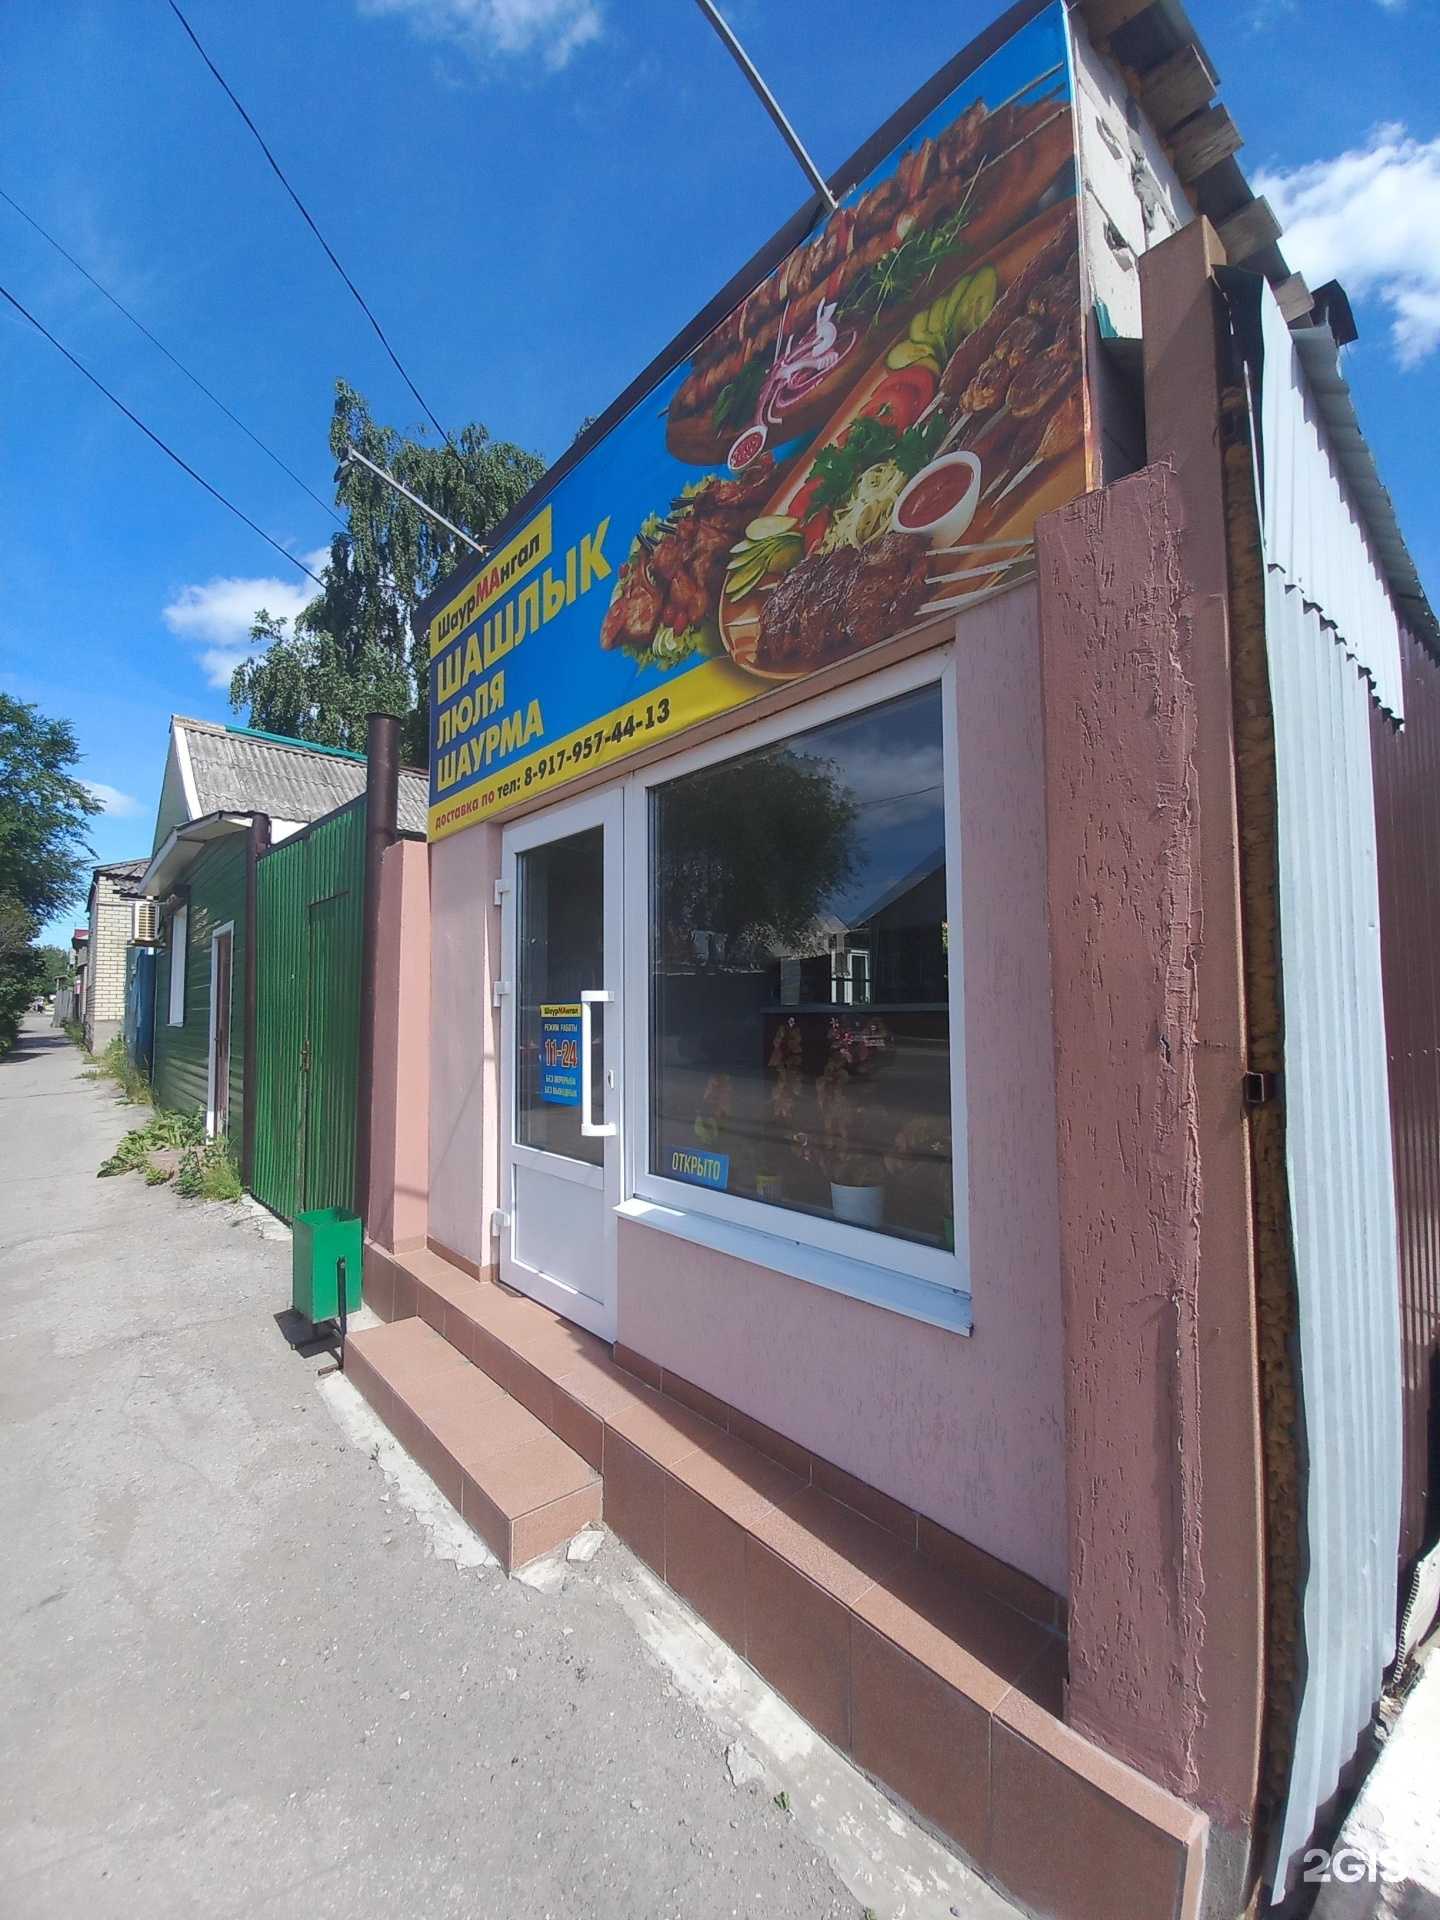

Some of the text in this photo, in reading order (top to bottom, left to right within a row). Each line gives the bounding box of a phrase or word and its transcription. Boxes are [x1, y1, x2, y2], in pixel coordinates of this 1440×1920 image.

[437, 533, 540, 642] ШаурМАнгал
[437, 515, 612, 704] ШАШЛЫК
[436, 670, 504, 748] ЛЮЛЯ
[437, 698, 544, 792] ШАУРМА
[435, 698, 670, 831] доставка по тел: 8-917-957-44-13
[544, 1038, 578, 1068] 11-24
[672, 1152, 721, 1181] ОТКРЫТО
